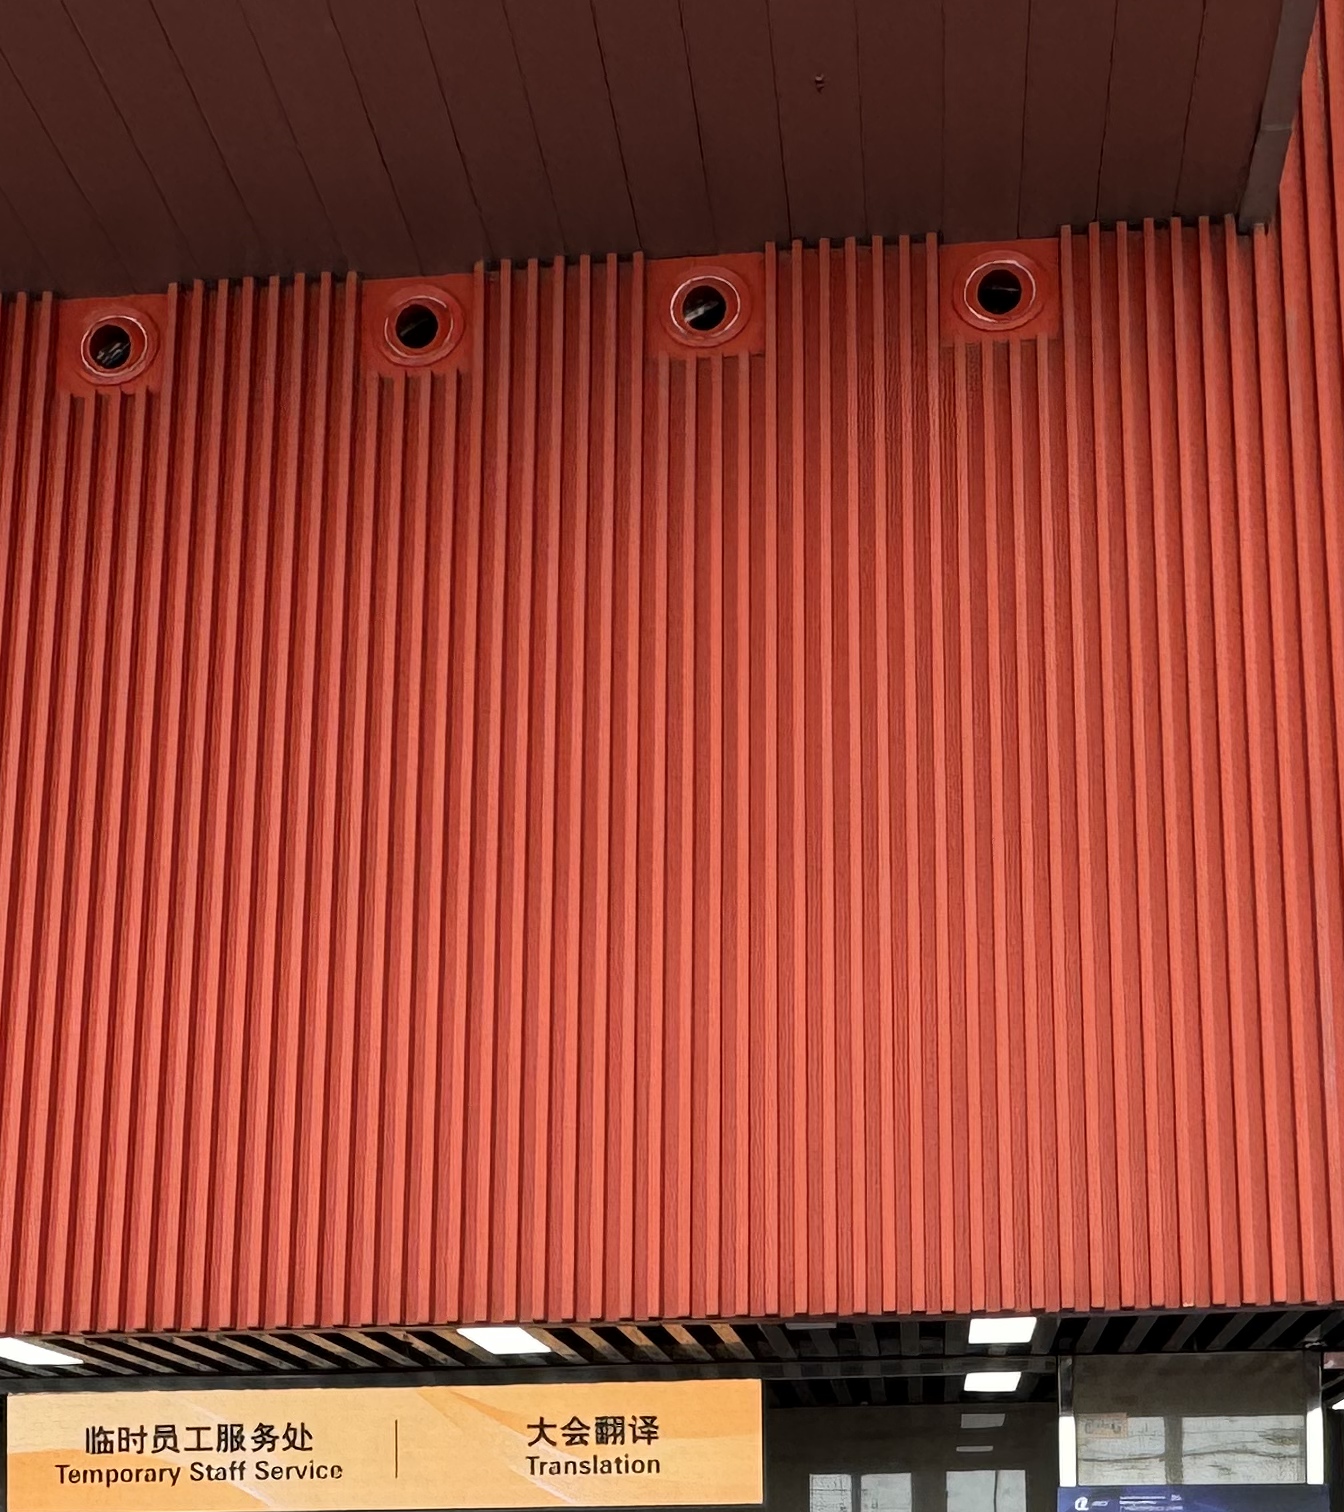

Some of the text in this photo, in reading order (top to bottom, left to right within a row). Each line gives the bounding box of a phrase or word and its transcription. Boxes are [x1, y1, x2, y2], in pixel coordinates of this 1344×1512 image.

[84, 1423, 314, 1455] 临时员工服务处
[526, 1415, 661, 1447] 大会翻译
[56, 1459, 344, 1487] Temporary Staff Service
[526, 1454, 662, 1476] Translation
